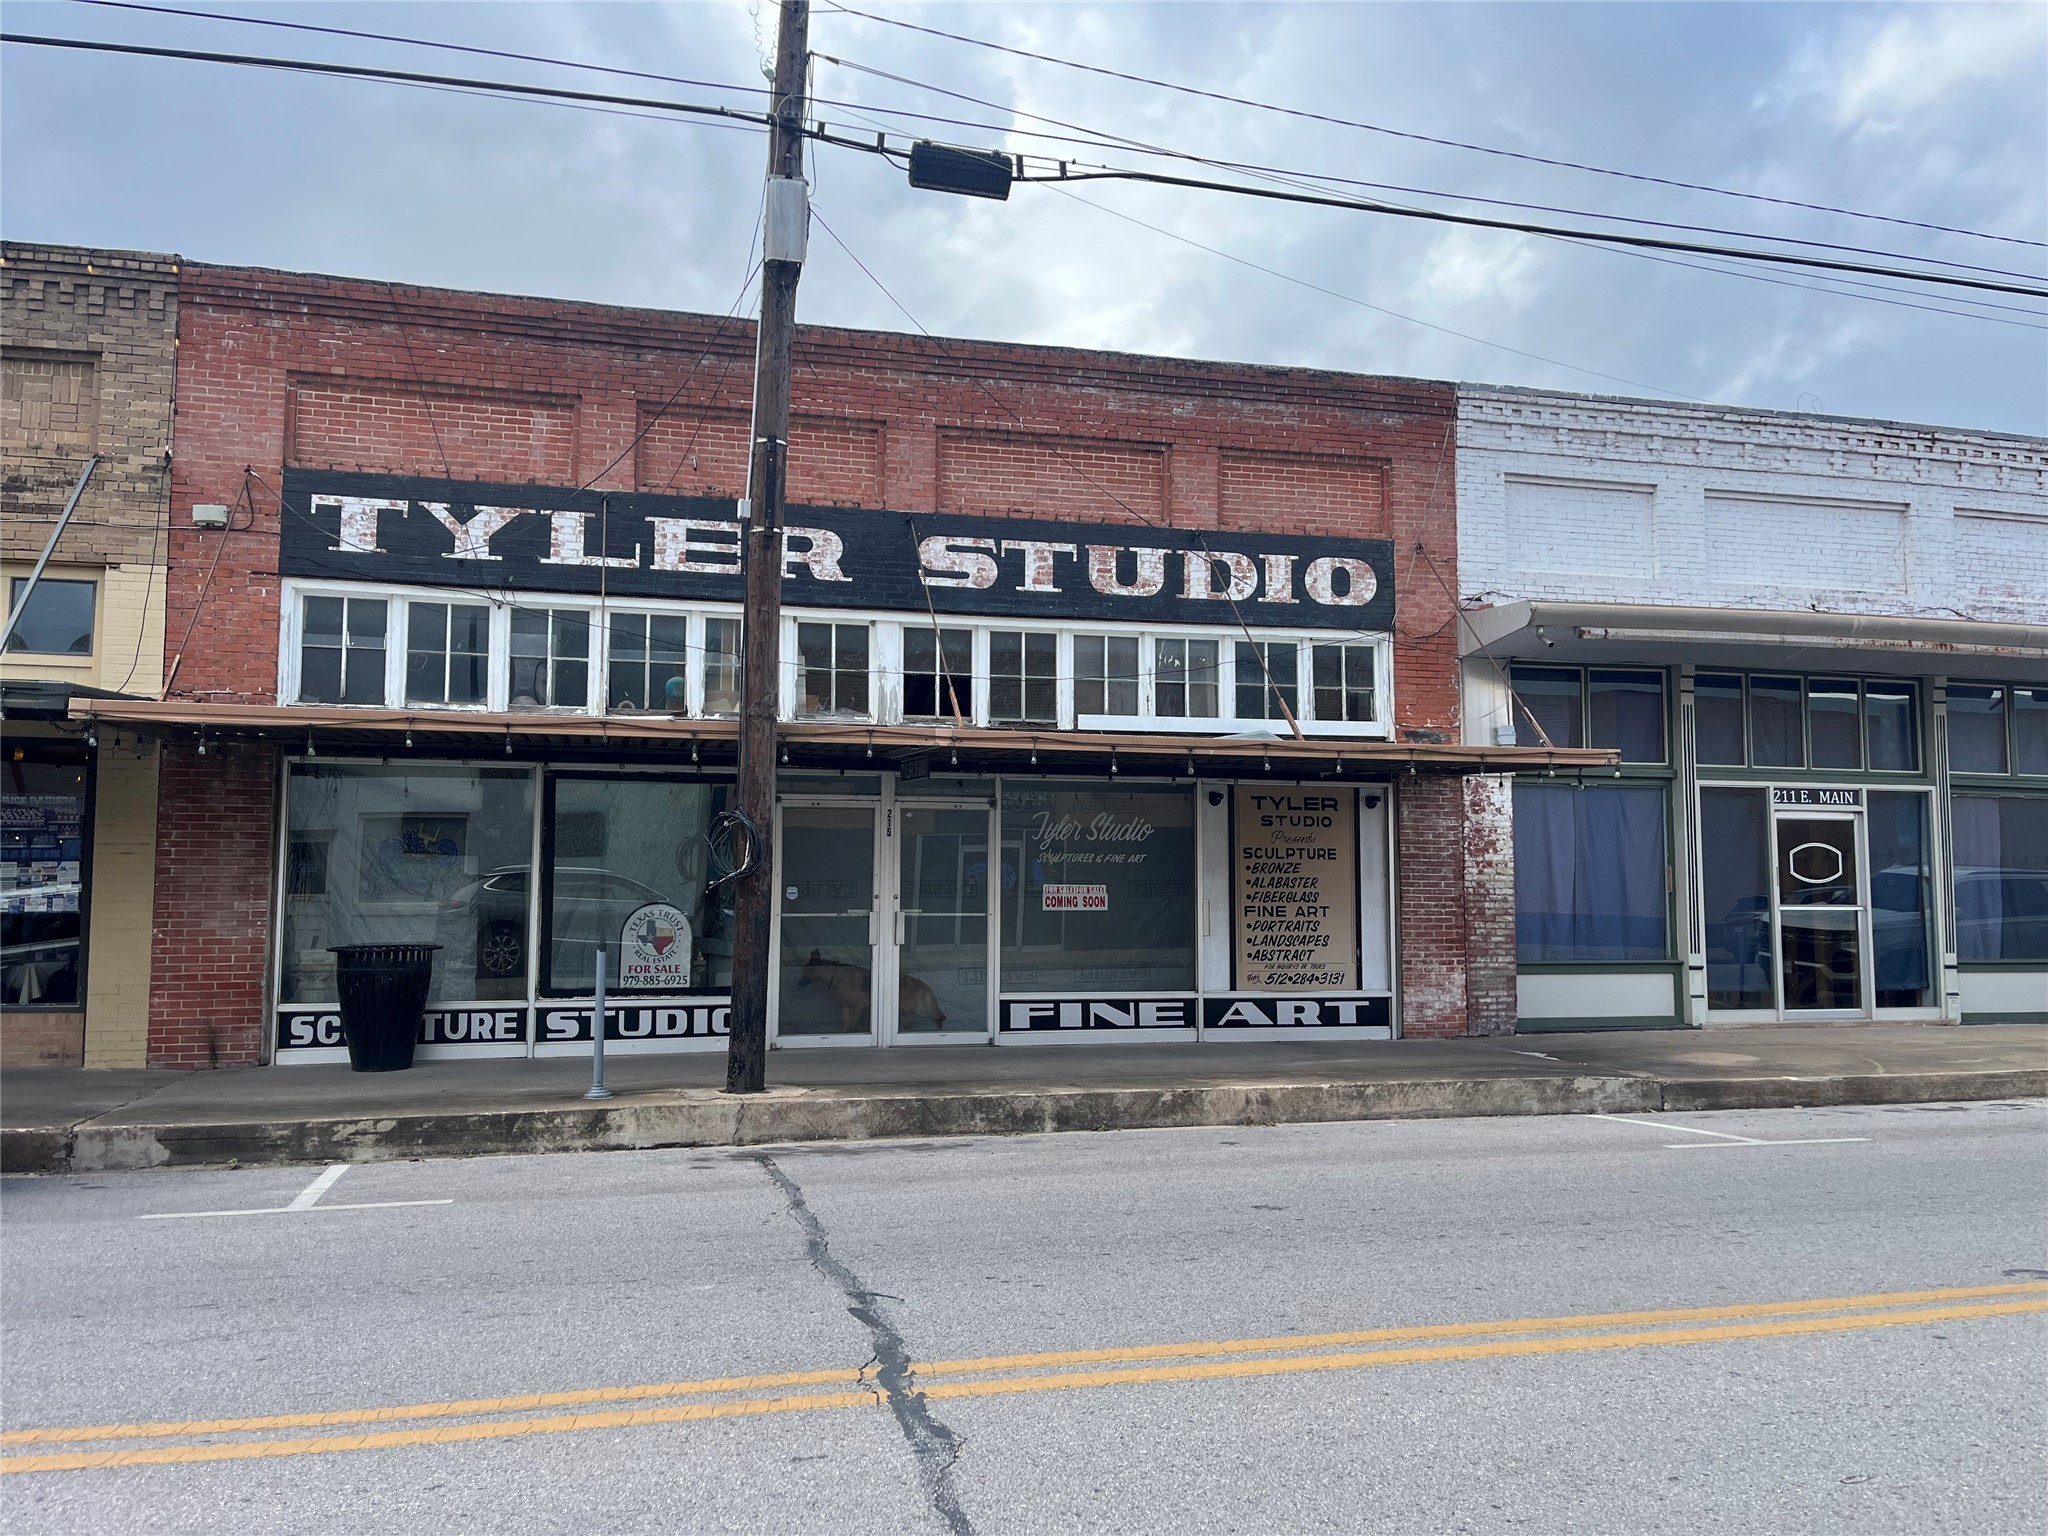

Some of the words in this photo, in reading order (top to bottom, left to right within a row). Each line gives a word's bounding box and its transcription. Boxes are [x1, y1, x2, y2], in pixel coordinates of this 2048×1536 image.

[310, 494, 853, 582] TYLER
[918, 534, 1377, 607] STUDIO
[1250, 795, 1339, 811] TYLER
[1773, 790, 1796, 803] 211
[1800, 791, 1812, 803] E.
[1820, 792, 1853, 804] MAIN
[1260, 815, 1333, 828] STUDIO
[1031, 811, 1082, 850] Tyler
[1085, 812, 1155, 842] Studio
[1270, 830, 1317, 845] Presents
[1036, 853, 1095, 863] SCULPTURES
[1095, 854, 1102, 863] &
[1103, 854, 1127, 863] FINE
[1127, 854, 1147, 863] ART
[1242, 847, 1337, 860] SCULPTURE
[1251, 863, 1302, 874] BRONZE
[1250, 877, 1318, 889] ALABASTER
[1045, 896, 1078, 908] COMING
[1082, 896, 1106, 907] SOON
[1250, 891, 1320, 903] FIBERGLASS
[1244, 905, 1287, 918] FINE
[1294, 905, 1330, 917] ART
[629, 909, 655, 932] TEXAS
[657, 909, 684, 932] TRUST
[1252, 920, 1320, 932] PORTRAITS
[1252, 935, 1330, 947] LANDSCAPES
[634, 949, 651, 963] REAL
[652, 949, 678, 964] ESTATE
[1252, 949, 1315, 962] ABSTRACT
[628, 965, 651, 974] FOR
[654, 965, 681, 974] SALE
[622, 975, 688, 986] 979-885-6925
[1009, 1001, 1185, 1029] FINE
[1217, 1001, 1370, 1026] ART
[290, 1012, 518, 1045] SCTURE
